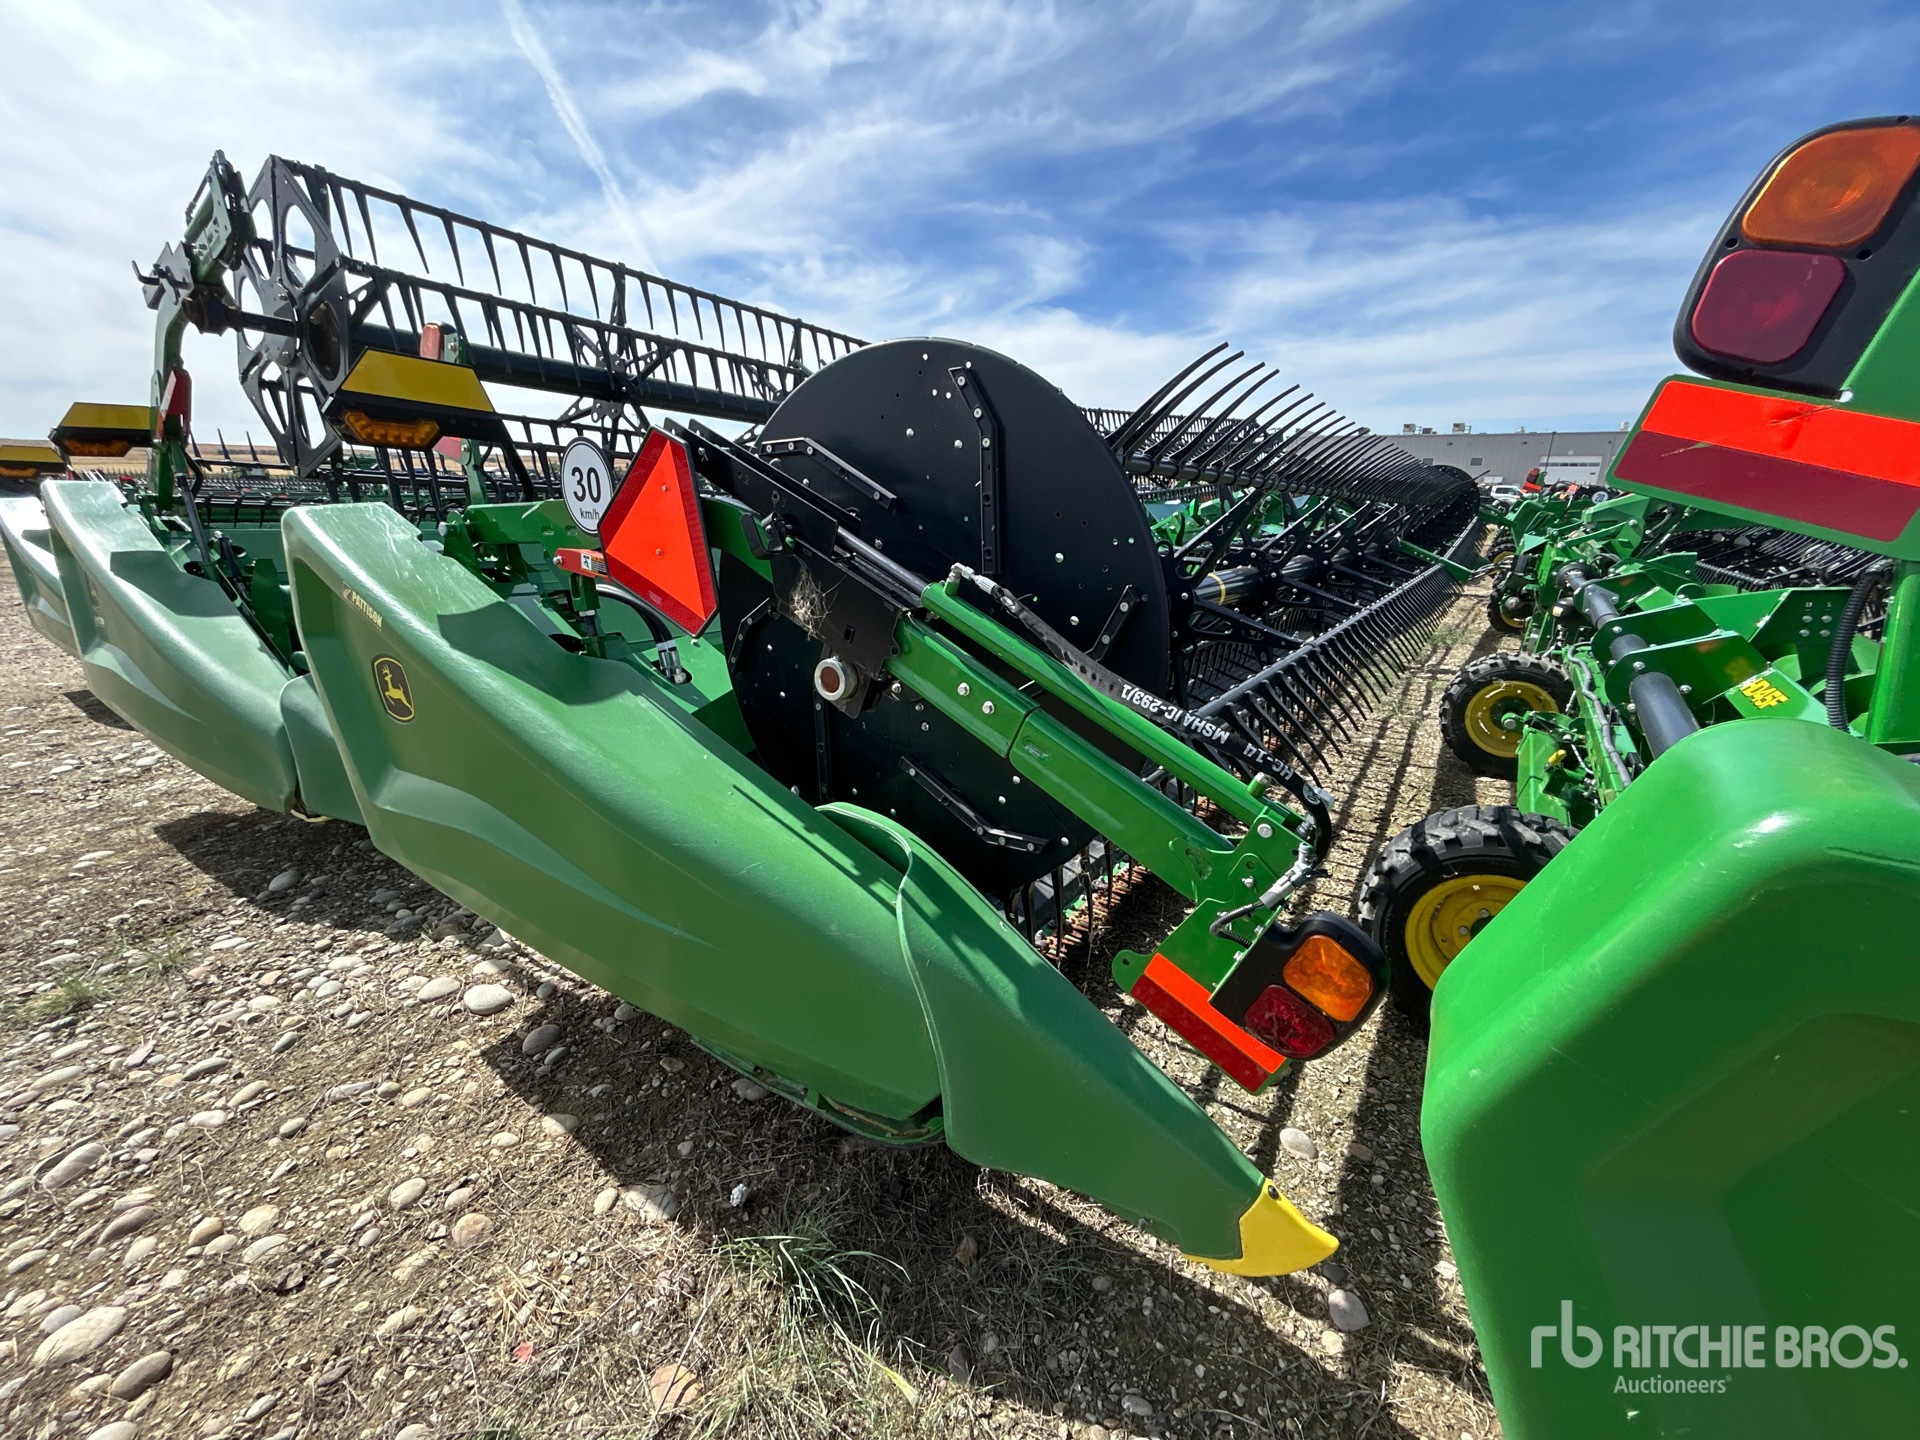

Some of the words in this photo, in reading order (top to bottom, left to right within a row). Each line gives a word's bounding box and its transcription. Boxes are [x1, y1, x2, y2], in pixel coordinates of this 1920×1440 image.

[571, 466, 601, 503] 30
[580, 508, 600, 520] km/h
[352, 590, 382, 628] PATTISON
[1121, 684, 1183, 722] IC-293/1
[1740, 677, 1789, 709] HD45F
[1183, 713, 1230, 744] MSHA
[1243, 743, 1293, 780] HC-14
